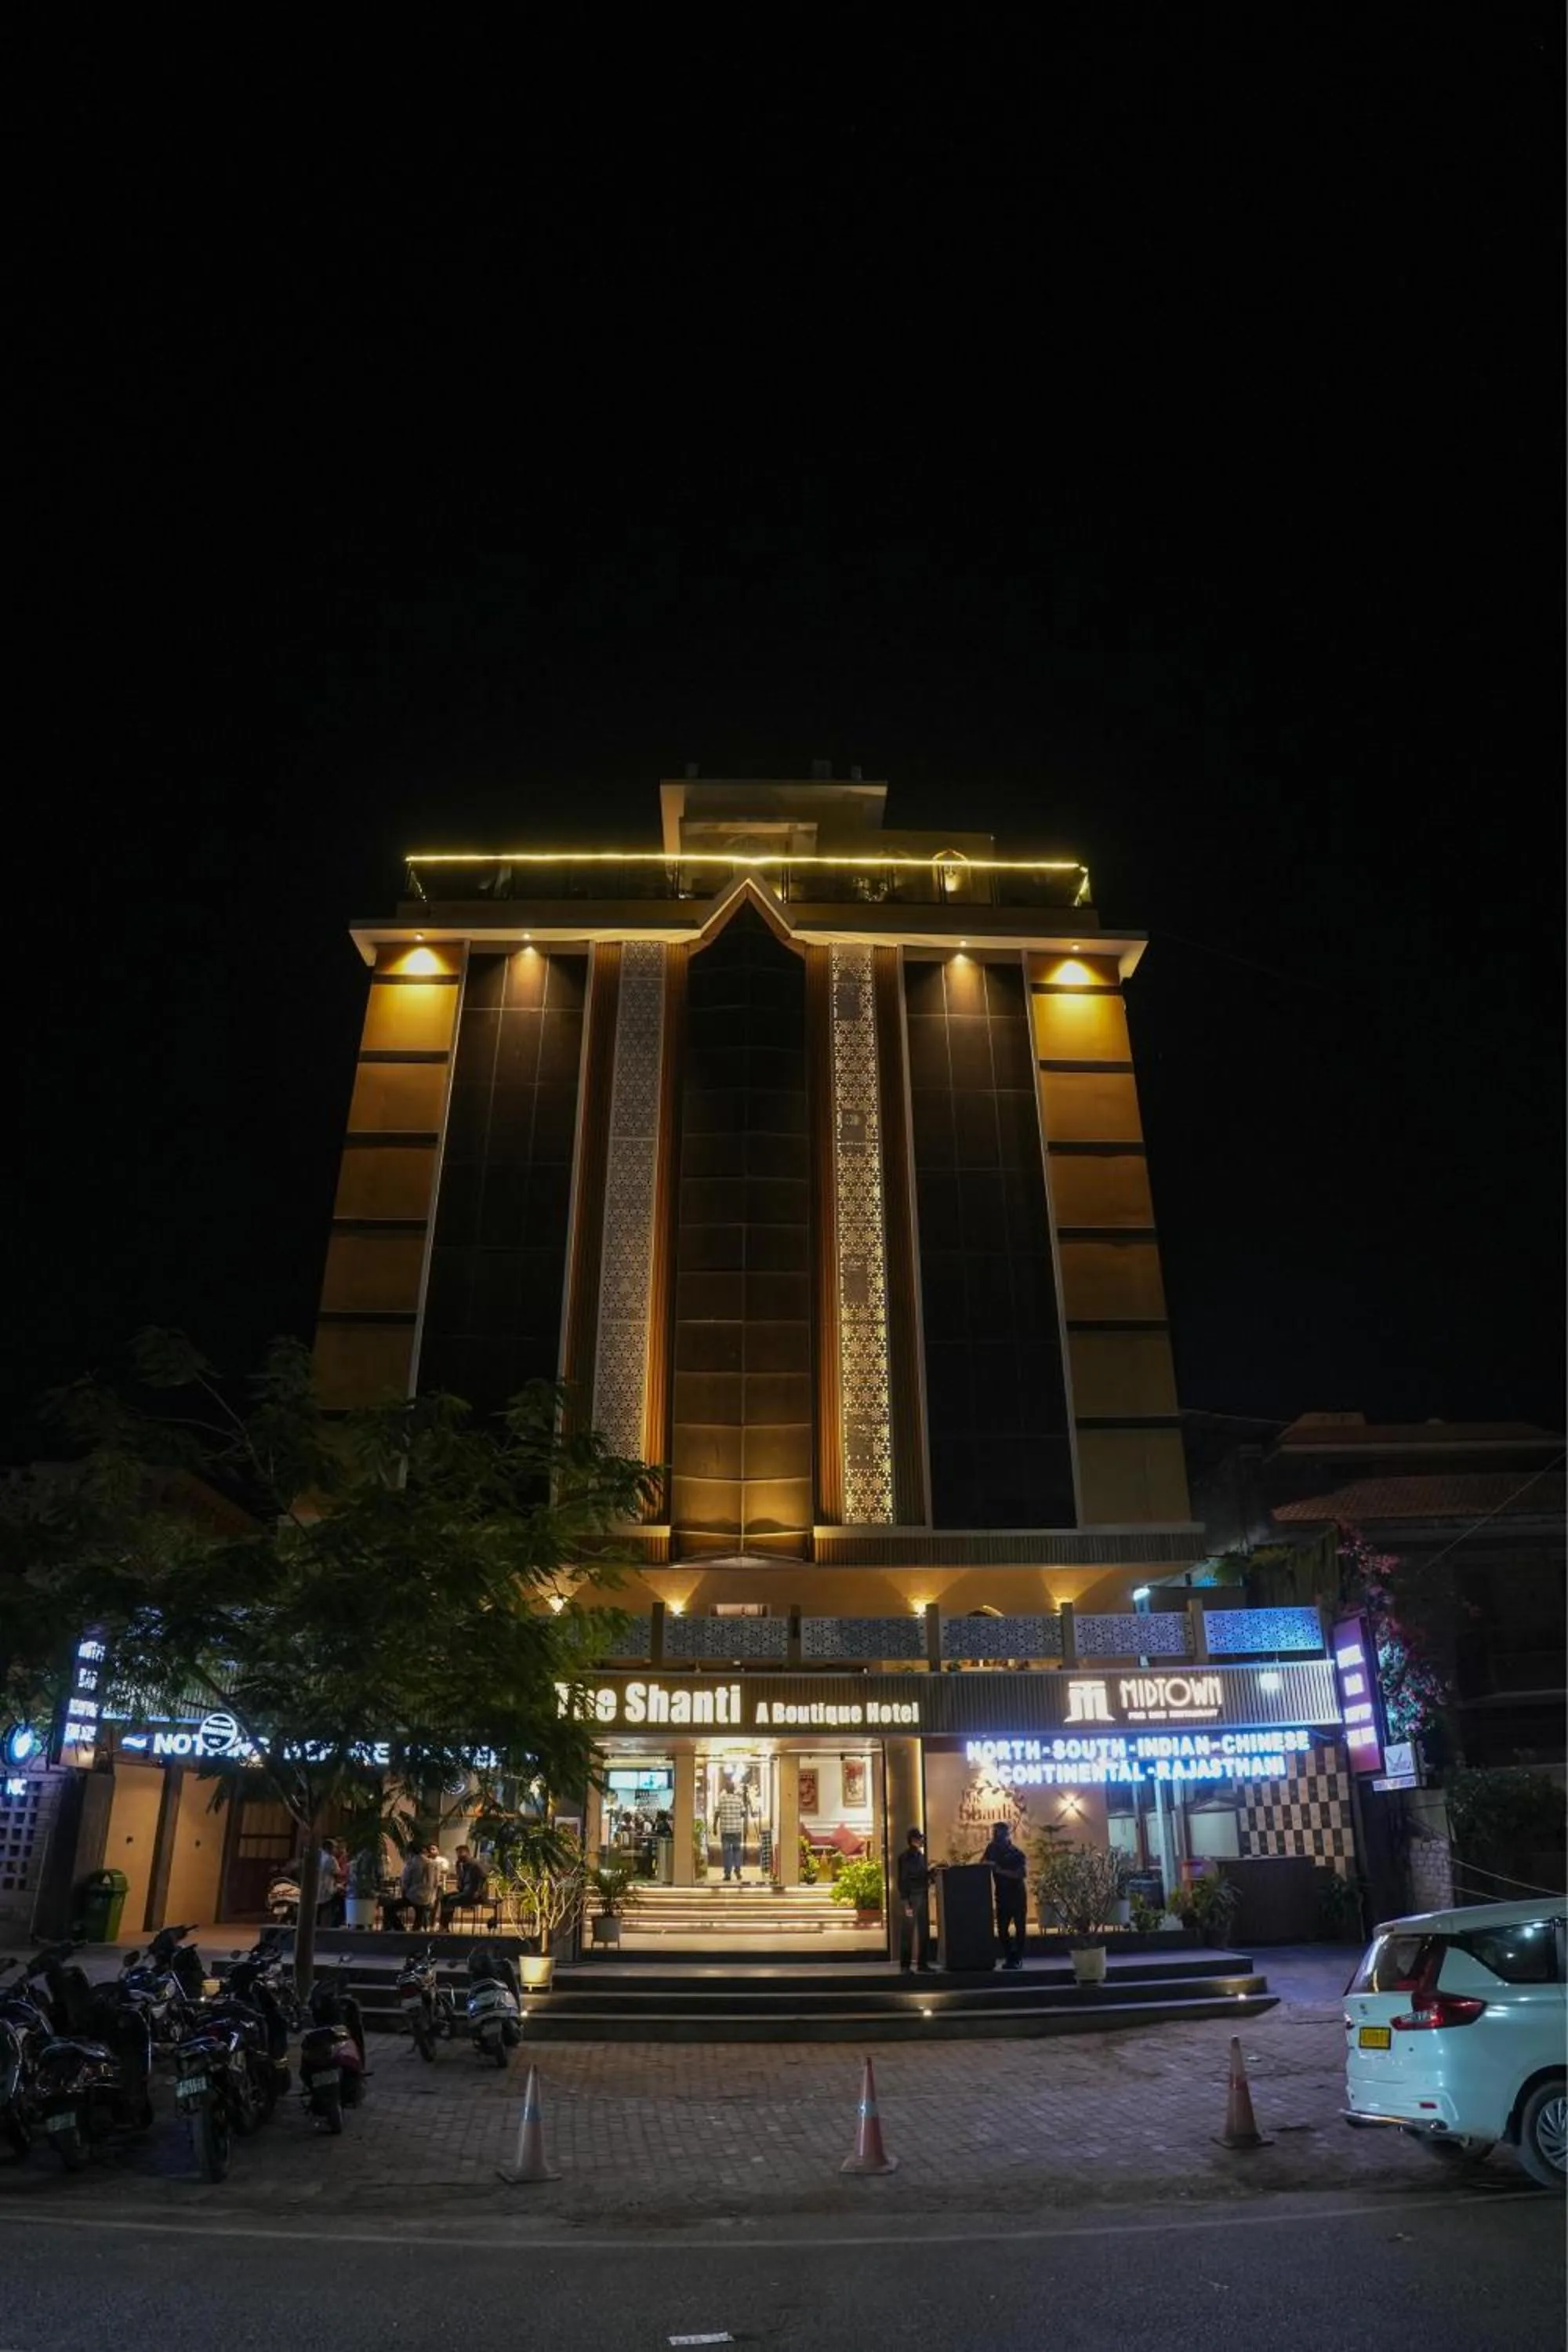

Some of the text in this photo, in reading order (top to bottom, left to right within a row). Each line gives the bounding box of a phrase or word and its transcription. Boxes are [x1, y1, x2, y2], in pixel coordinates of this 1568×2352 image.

[625, 1682, 740, 1723] Shanti
[755, 1702, 769, 1724] A
[772, 1702, 862, 1725] Boutique
[866, 1701, 919, 1723] Hotel
[1120, 1676, 1223, 1709] MIDTOWN
